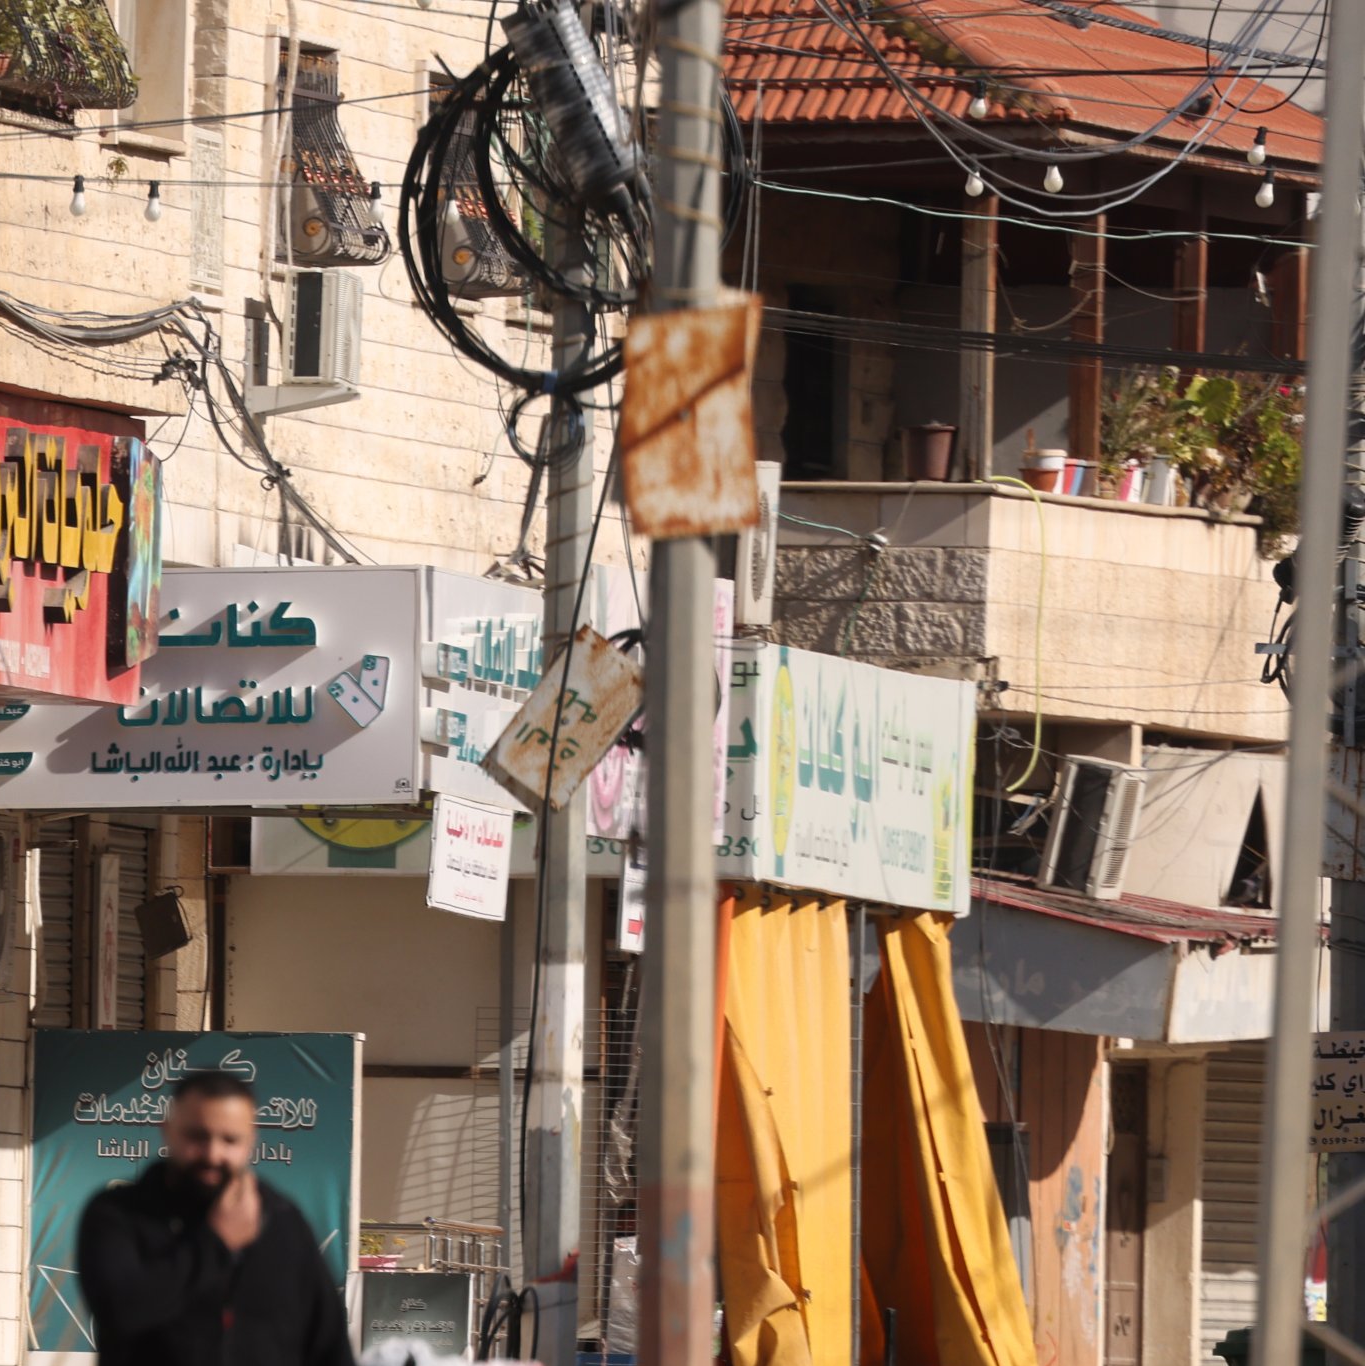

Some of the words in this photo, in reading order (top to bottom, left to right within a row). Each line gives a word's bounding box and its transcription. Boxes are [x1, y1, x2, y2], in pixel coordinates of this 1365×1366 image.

[91, 742, 162, 782] الباشا
[164, 736, 200, 773] الله
[206, 753, 242, 781] عبد
[140, 1047, 257, 1089] كنان
[1311, 1072, 1336, 1098] كلي
[251, 1095, 318, 1129] للاتص
[97, 1137, 149, 1159] الباشا
[251, 1142, 292, 1165] بادار
[1321, 1136, 1365, 1146] 0599-29
